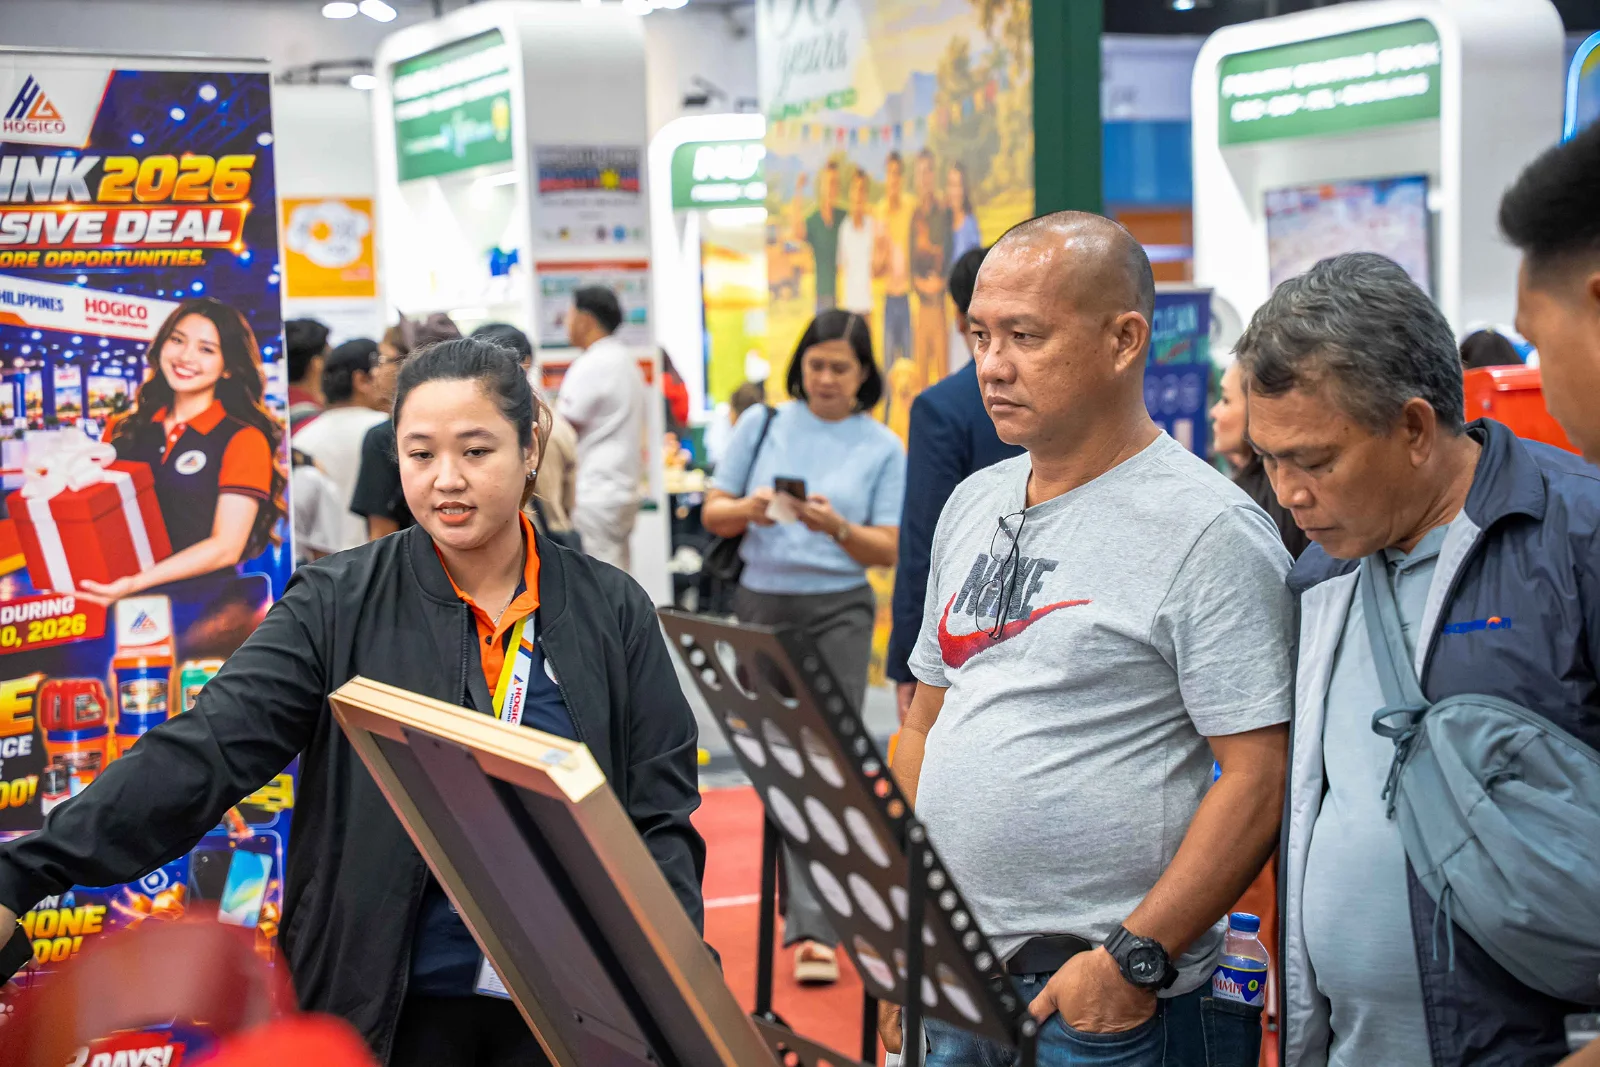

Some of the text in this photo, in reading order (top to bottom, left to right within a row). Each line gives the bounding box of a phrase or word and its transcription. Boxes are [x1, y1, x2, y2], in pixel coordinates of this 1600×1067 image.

[3, 120, 66, 134] HOGICO
[0, 154, 256, 202] INK 2026
[0, 210, 232, 244] SIVE DEAL
[0, 250, 206, 269] ORE OPPORTUNITIES.
[85, 298, 147, 320] HOGICO
[1, 596, 75, 625] DURING
[28, 613, 87, 643] 2026
[0, 734, 33, 759] CE
